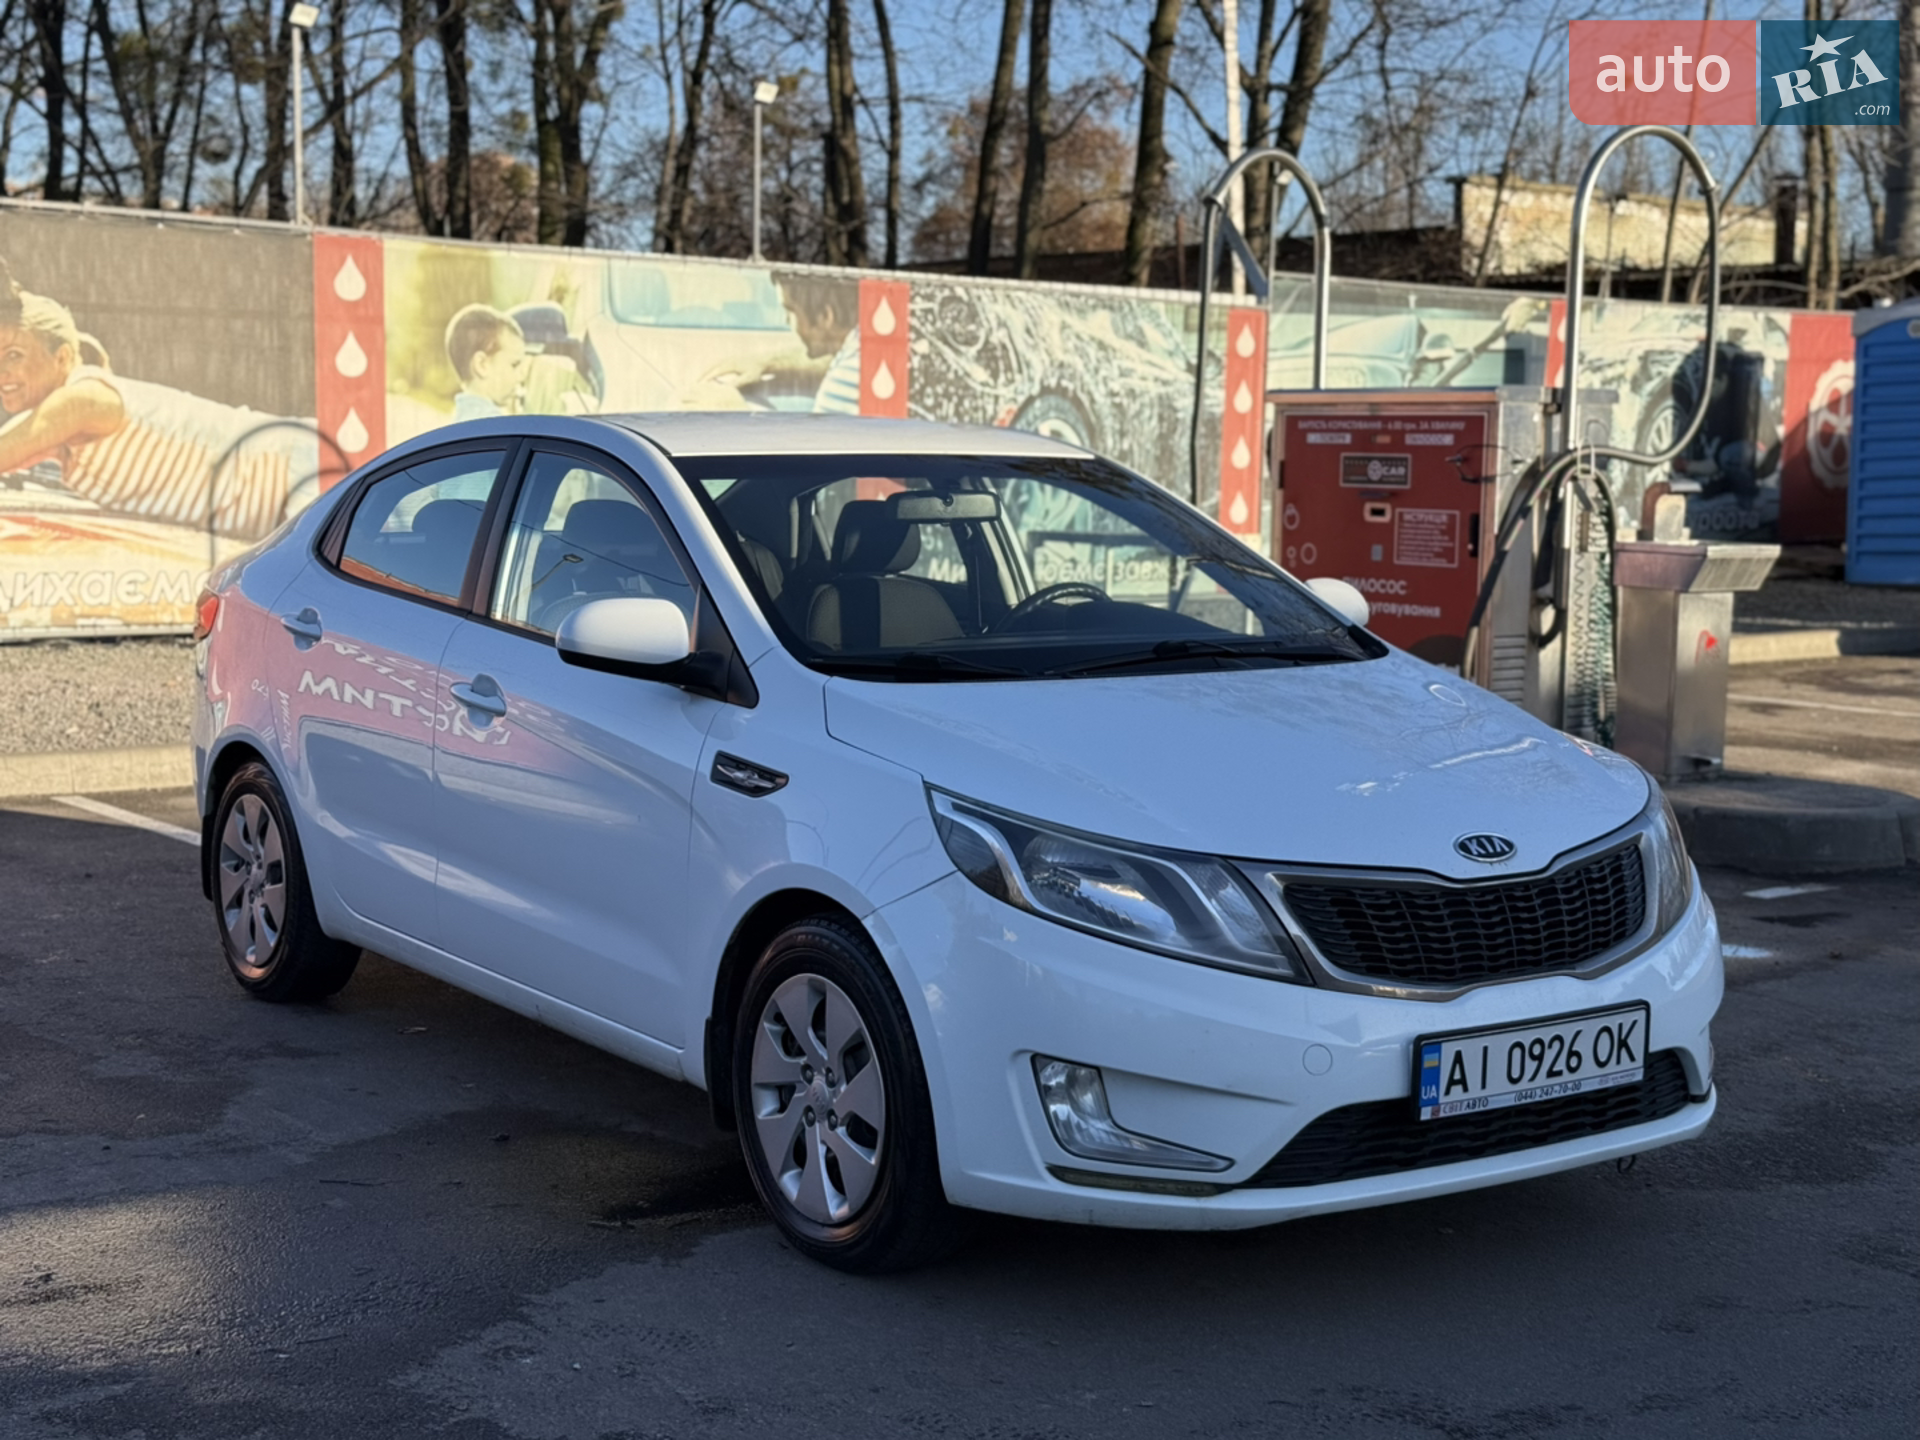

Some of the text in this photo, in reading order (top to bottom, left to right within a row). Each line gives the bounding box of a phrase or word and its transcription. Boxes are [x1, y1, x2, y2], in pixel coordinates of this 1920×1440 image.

[1369, 601, 1441, 618] уговування
[1463, 836, 1510, 855] KIA
[1443, 1019, 1638, 1096] AI 0926 OK
[1422, 1085, 1438, 1100] UA
